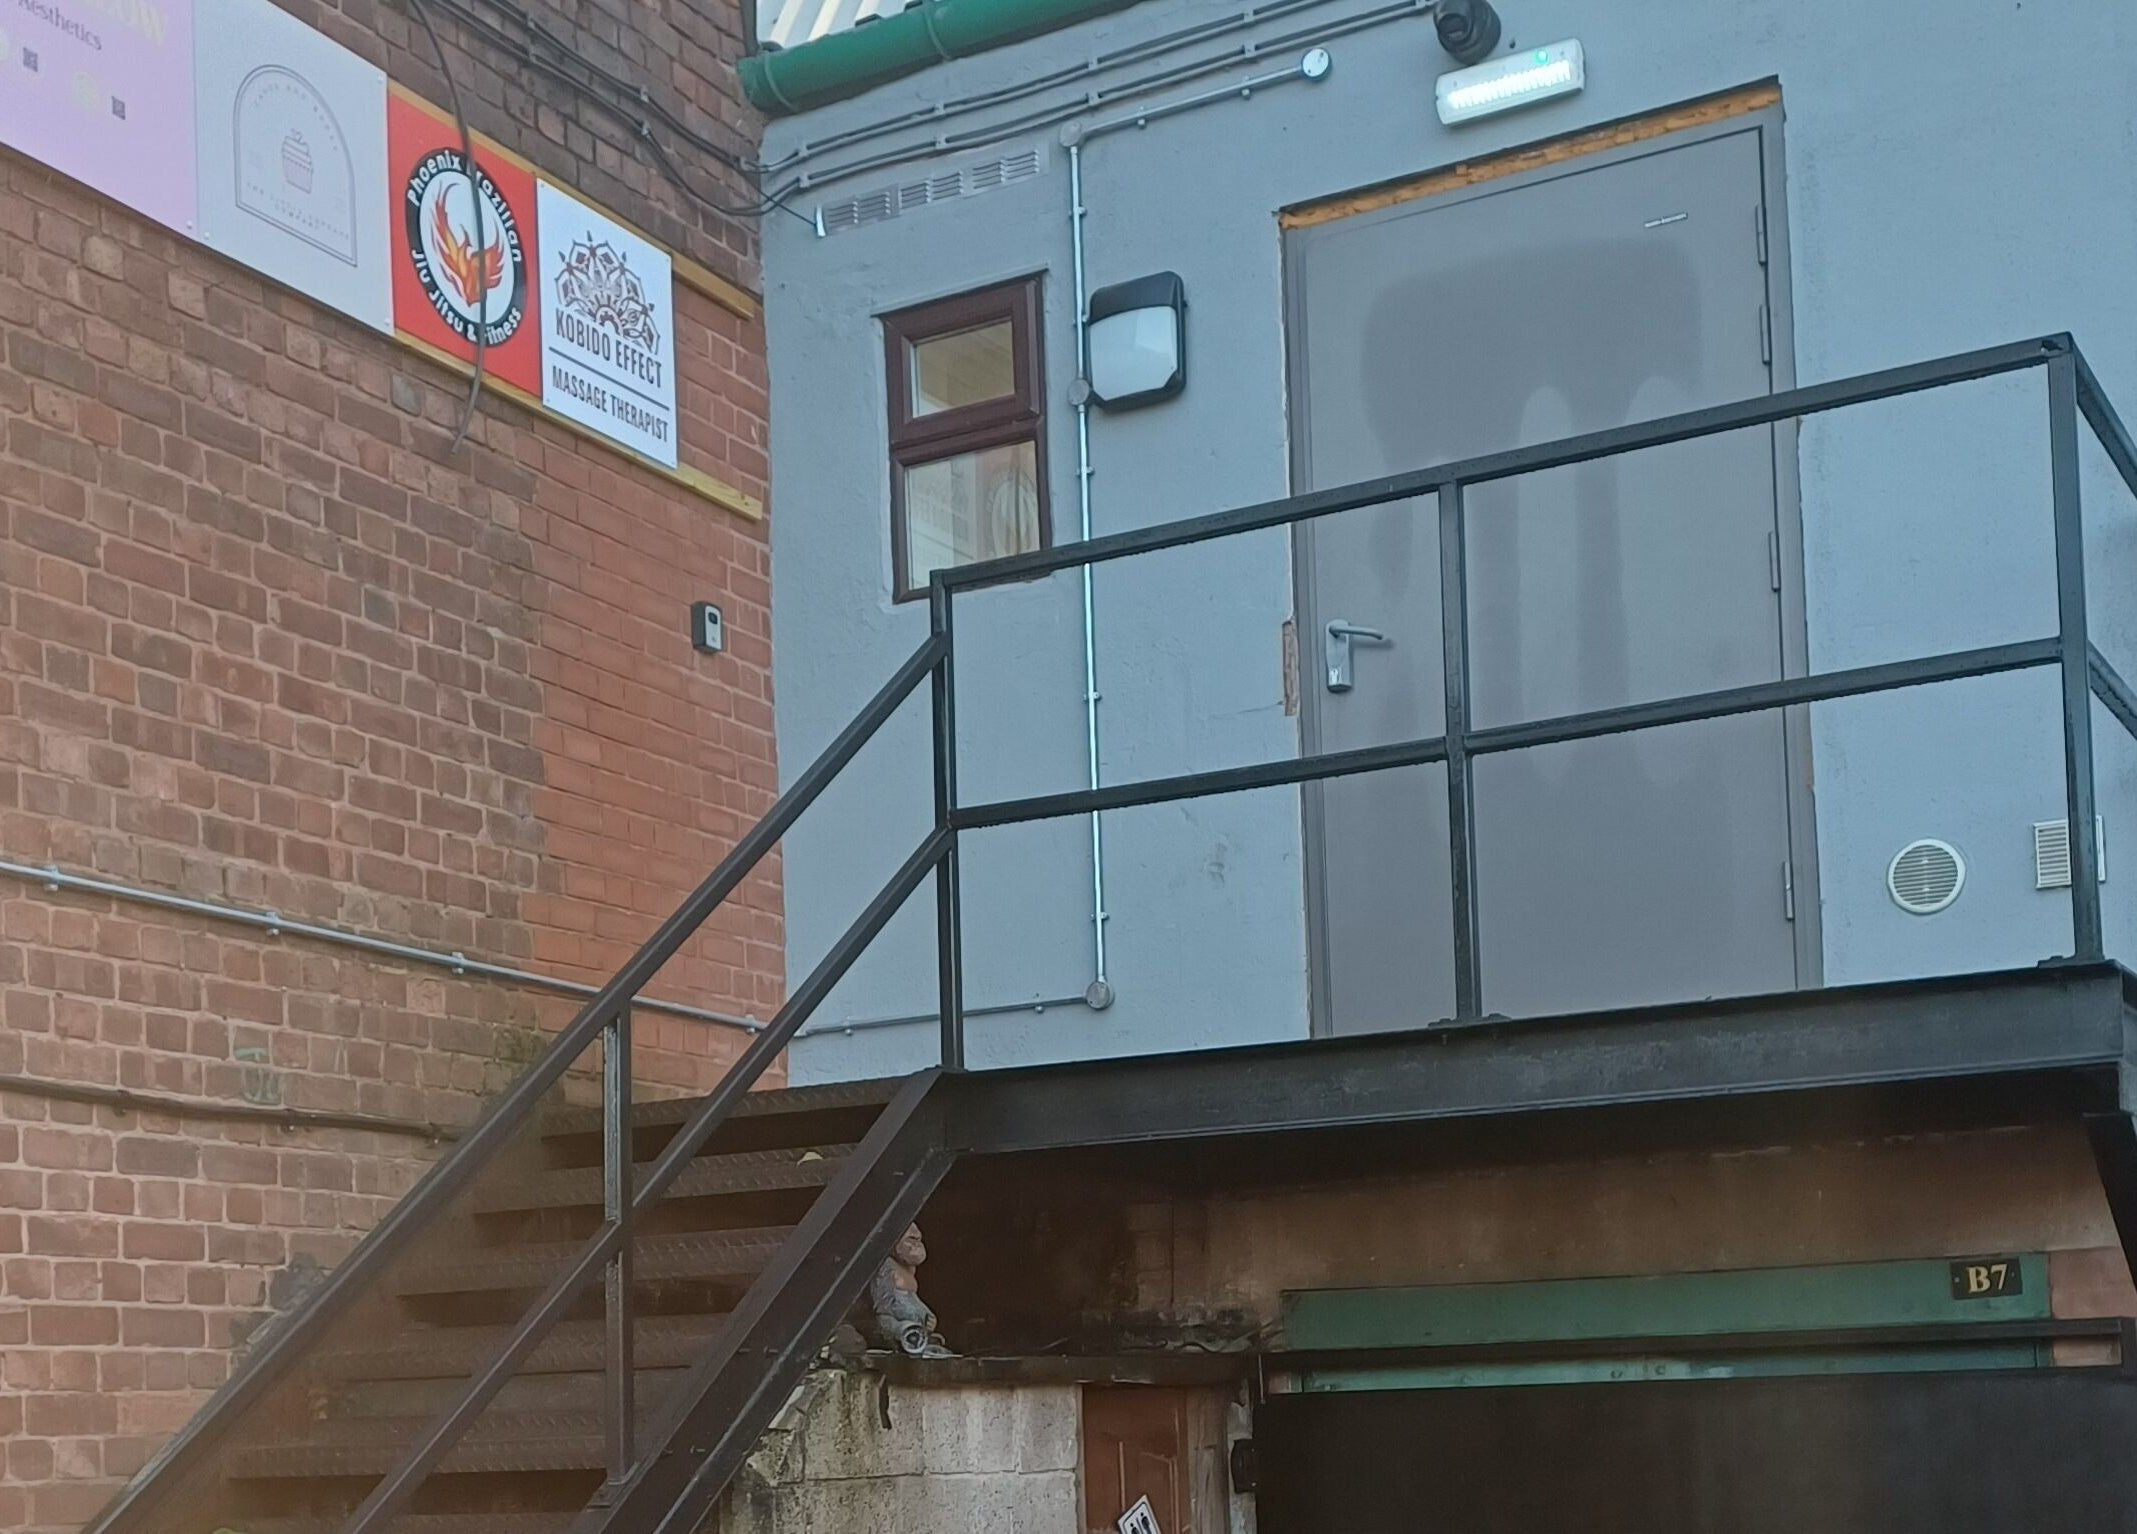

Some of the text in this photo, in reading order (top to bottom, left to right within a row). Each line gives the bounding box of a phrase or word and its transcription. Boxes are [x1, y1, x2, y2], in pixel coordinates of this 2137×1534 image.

[407, 150, 521, 262] Phoenix razilian
[411, 249, 430, 283] Jiu
[428, 290, 464, 332] Jitsu
[484, 306, 521, 345] itness
[555, 307, 662, 388] KOBIDO EFFECT
[552, 365, 669, 442] MASSAGE THERAPIST
[1965, 1263, 2008, 1294] B7
